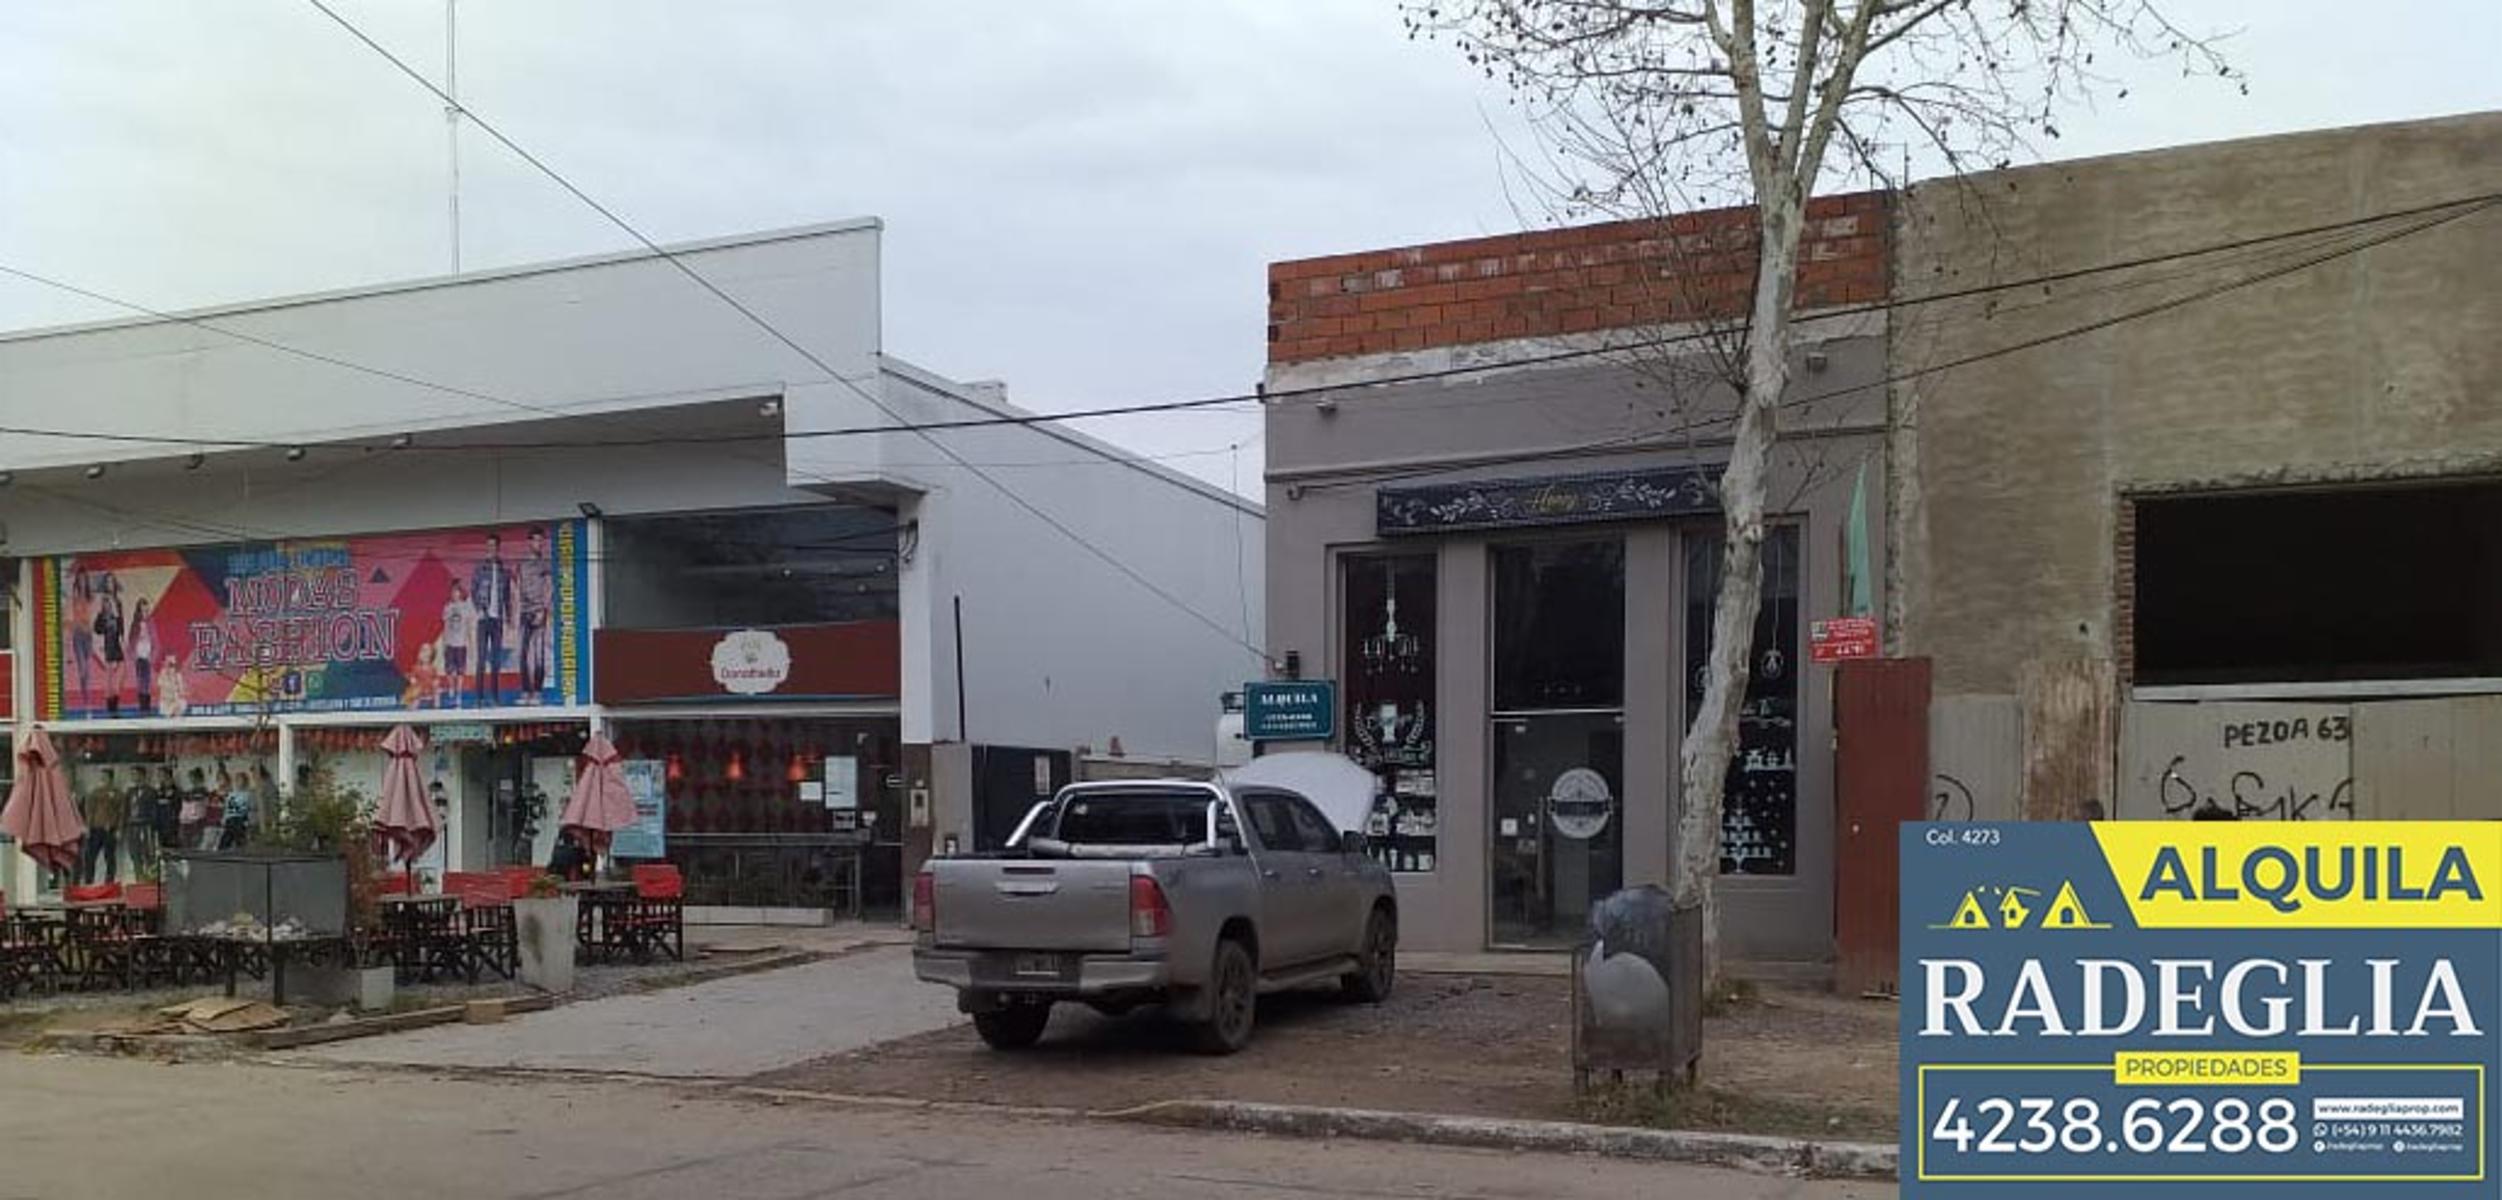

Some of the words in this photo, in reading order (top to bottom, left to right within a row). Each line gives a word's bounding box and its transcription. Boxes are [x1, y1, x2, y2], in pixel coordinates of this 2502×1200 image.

[223, 567, 358, 616] MODAS
[188, 607, 400, 671] FASHION
[1260, 693, 1319, 708] ALQUILA
[2223, 718, 2309, 748] PEZOA
